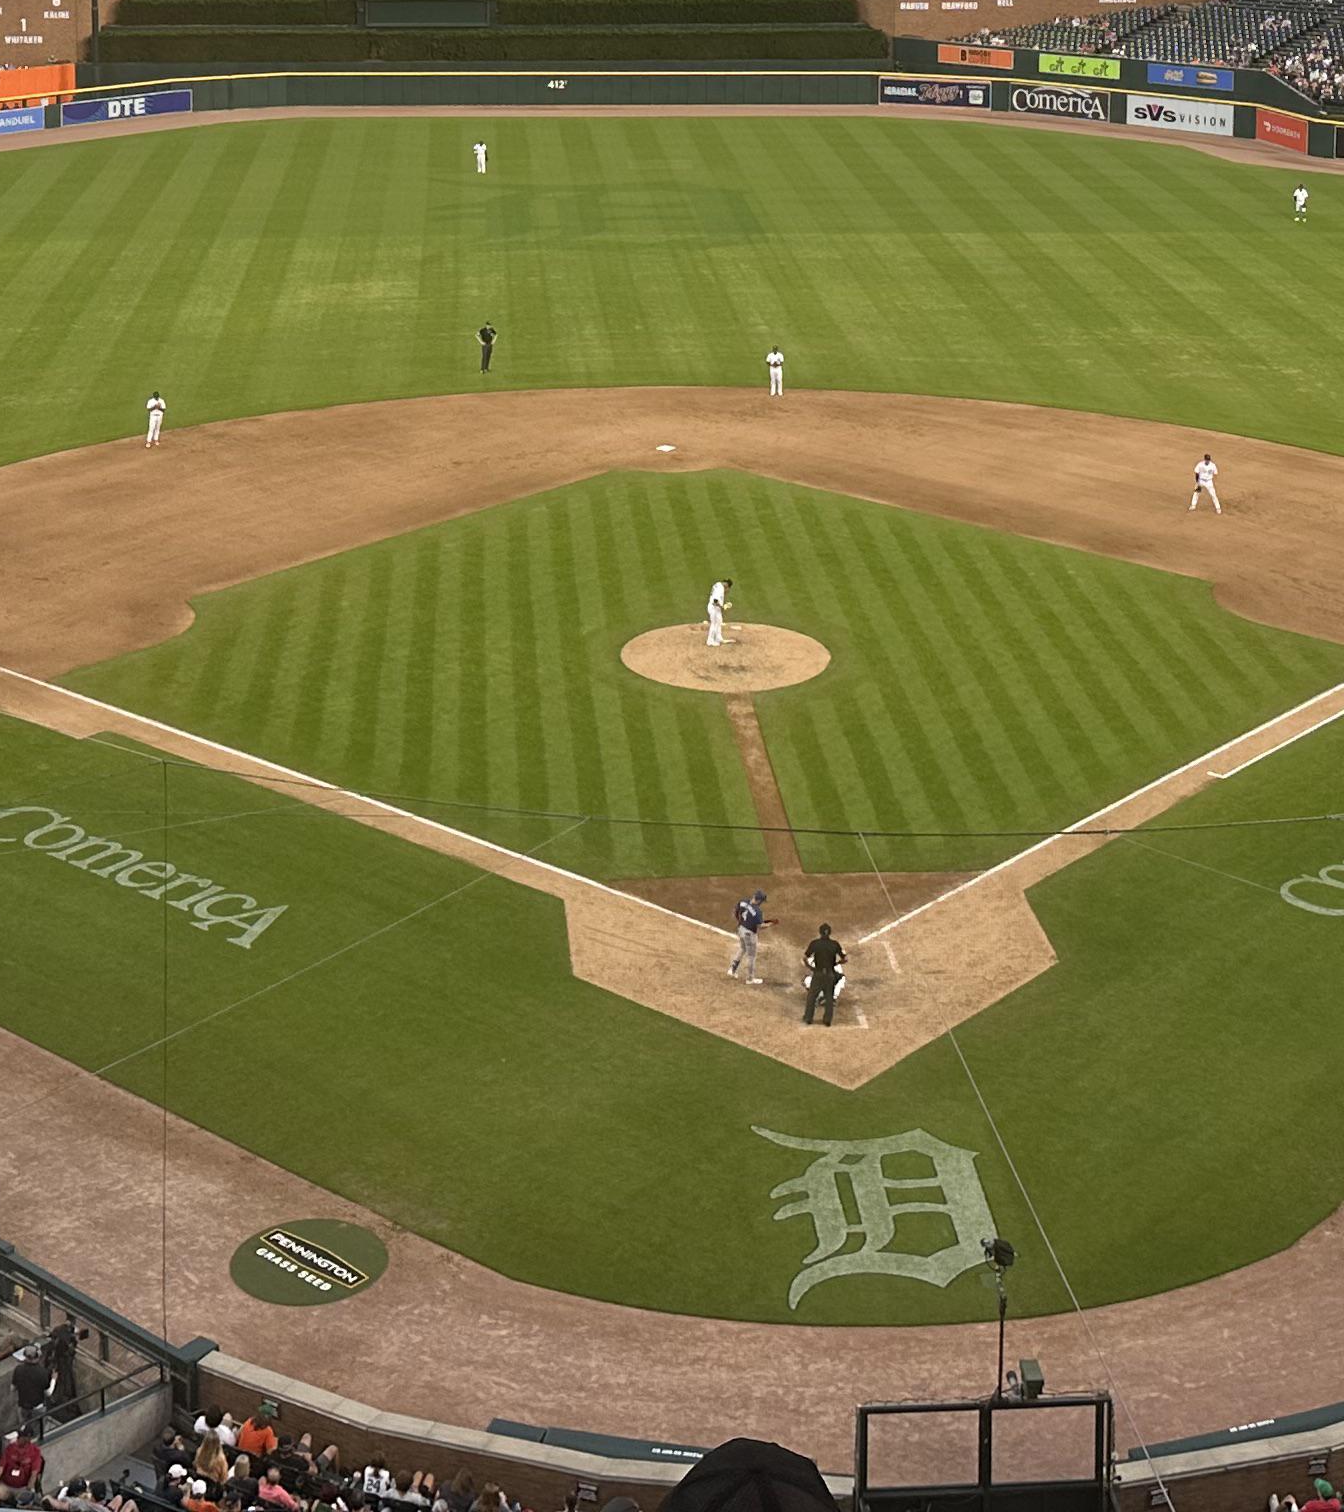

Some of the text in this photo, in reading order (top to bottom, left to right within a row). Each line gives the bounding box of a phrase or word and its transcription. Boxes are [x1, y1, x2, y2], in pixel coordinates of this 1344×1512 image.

[20, 19, 26, 32] 1
[108, 96, 146, 117] DTE
[1012, 89, 1105, 120] Comerica
[1180, 114, 1226, 127] VISION
[751, 1124, 999, 1310] D
[256, 1248, 332, 1291] GRASS SEED
[270, 1233, 357, 1283] PENNINGTON
